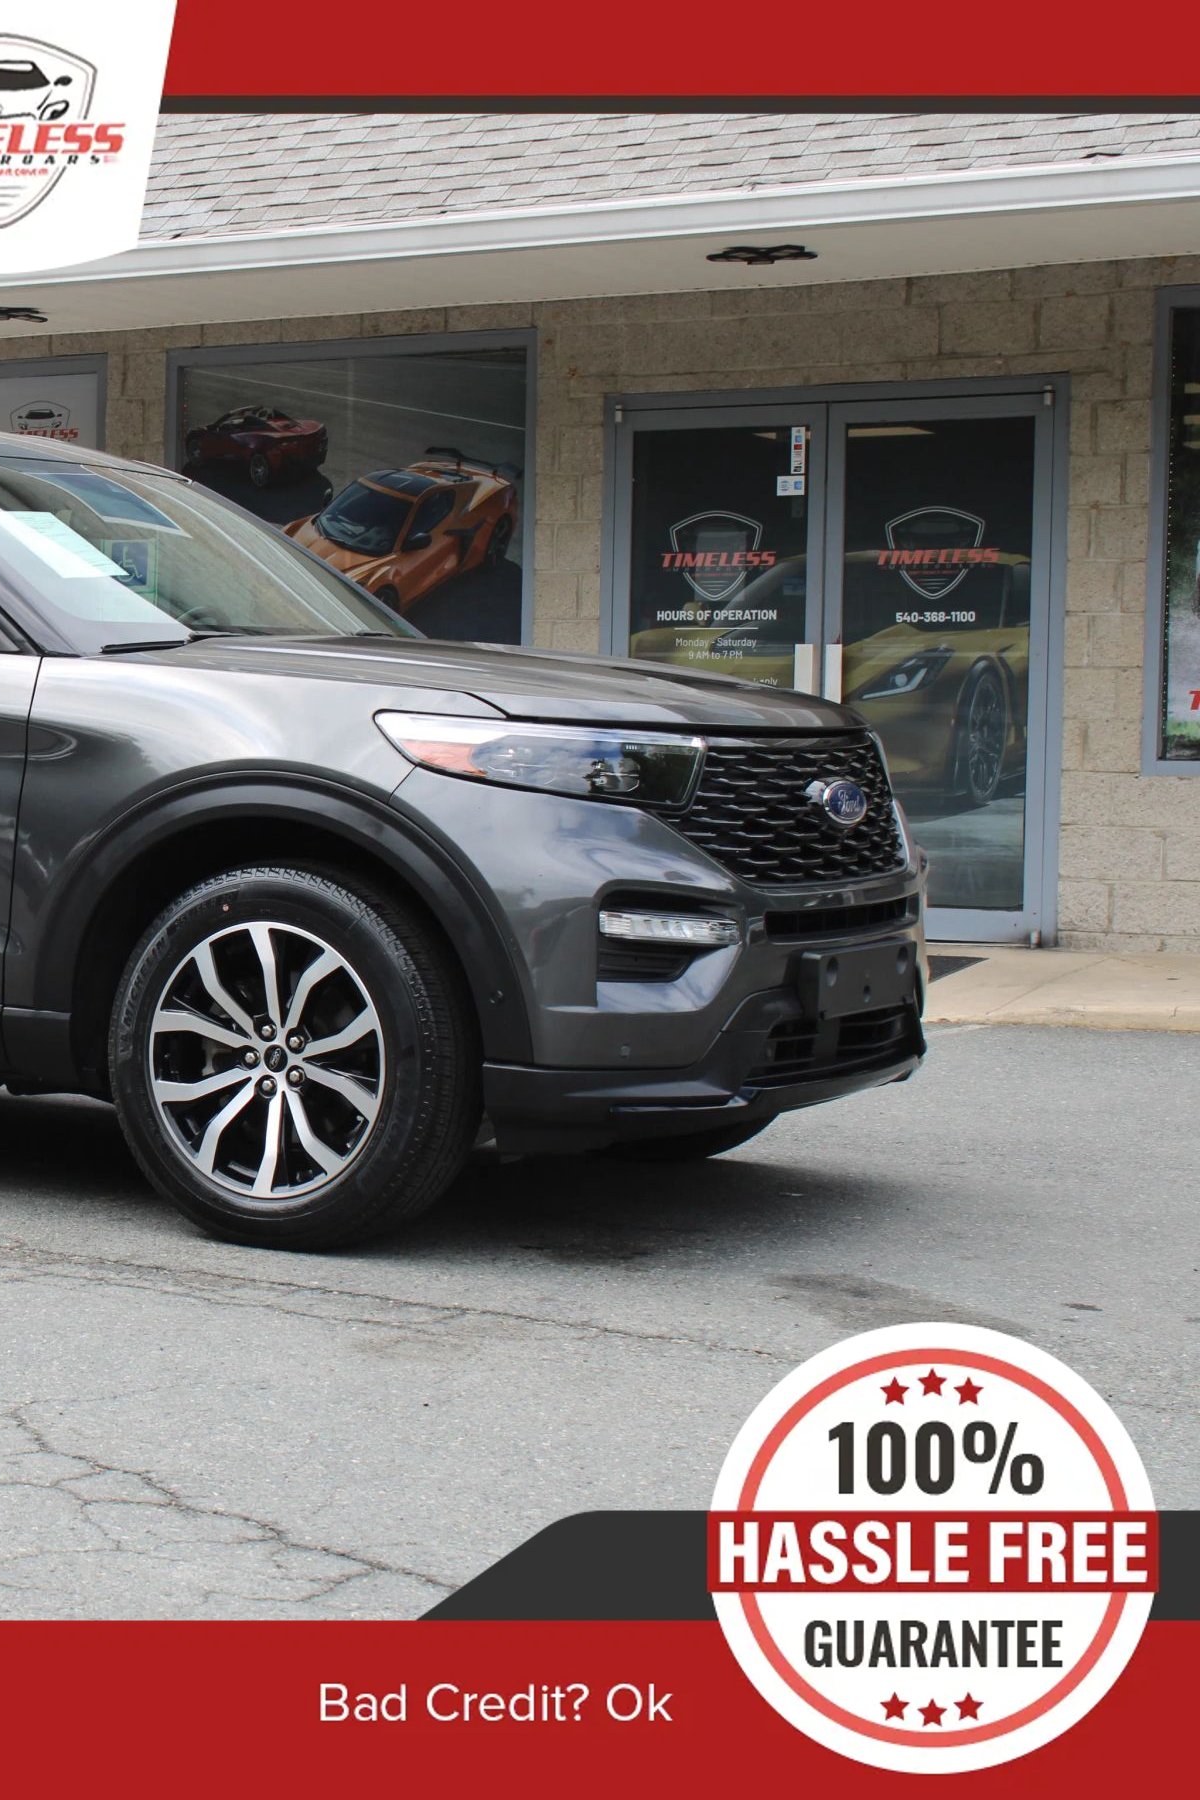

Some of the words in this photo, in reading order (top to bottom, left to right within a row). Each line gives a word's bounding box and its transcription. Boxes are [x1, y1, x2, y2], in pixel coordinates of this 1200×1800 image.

[661, 552, 776, 568] TIMELESS
[877, 548, 1000, 566] TIMELESS
[656, 610, 694, 621] HOURS
[697, 610, 711, 620] OF
[713, 609, 777, 620] OPERATION
[895, 611, 976, 623] 540-368-1100
[675, 638, 709, 648] Monday
[716, 638, 757, 648] Saturday
[688, 652, 693, 660] 9
[695, 651, 709, 660] AM
[711, 651, 720, 659] to
[722, 651, 728, 659] 7
[729, 651, 743, 660] PM
[837, 789, 862, 815] Ford
